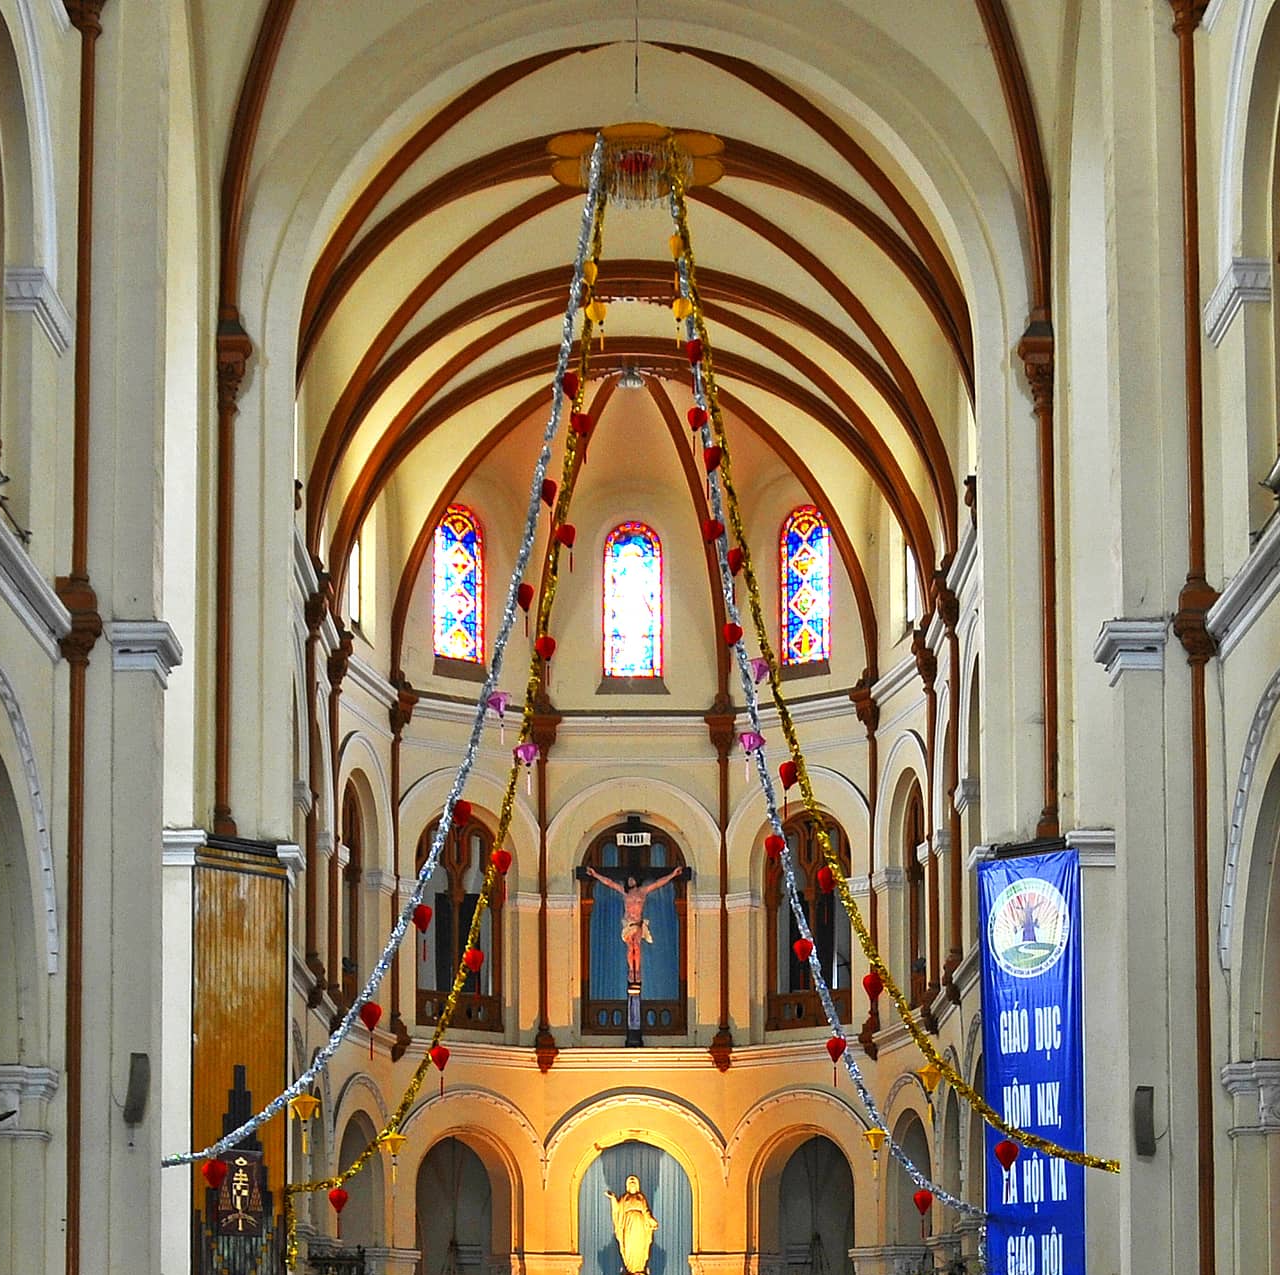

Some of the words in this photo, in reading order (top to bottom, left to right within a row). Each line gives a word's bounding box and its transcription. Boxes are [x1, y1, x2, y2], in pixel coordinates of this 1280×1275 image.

[623, 834, 644, 844] INRI
[1000, 1001, 1029, 1055] GIÁO
[1035, 1005, 1061, 1060] DỤC
[1003, 1077, 1031, 1130] HÔM
[1037, 1081, 1061, 1128] NAY,
[1023, 1151, 1045, 1213] HỘI
